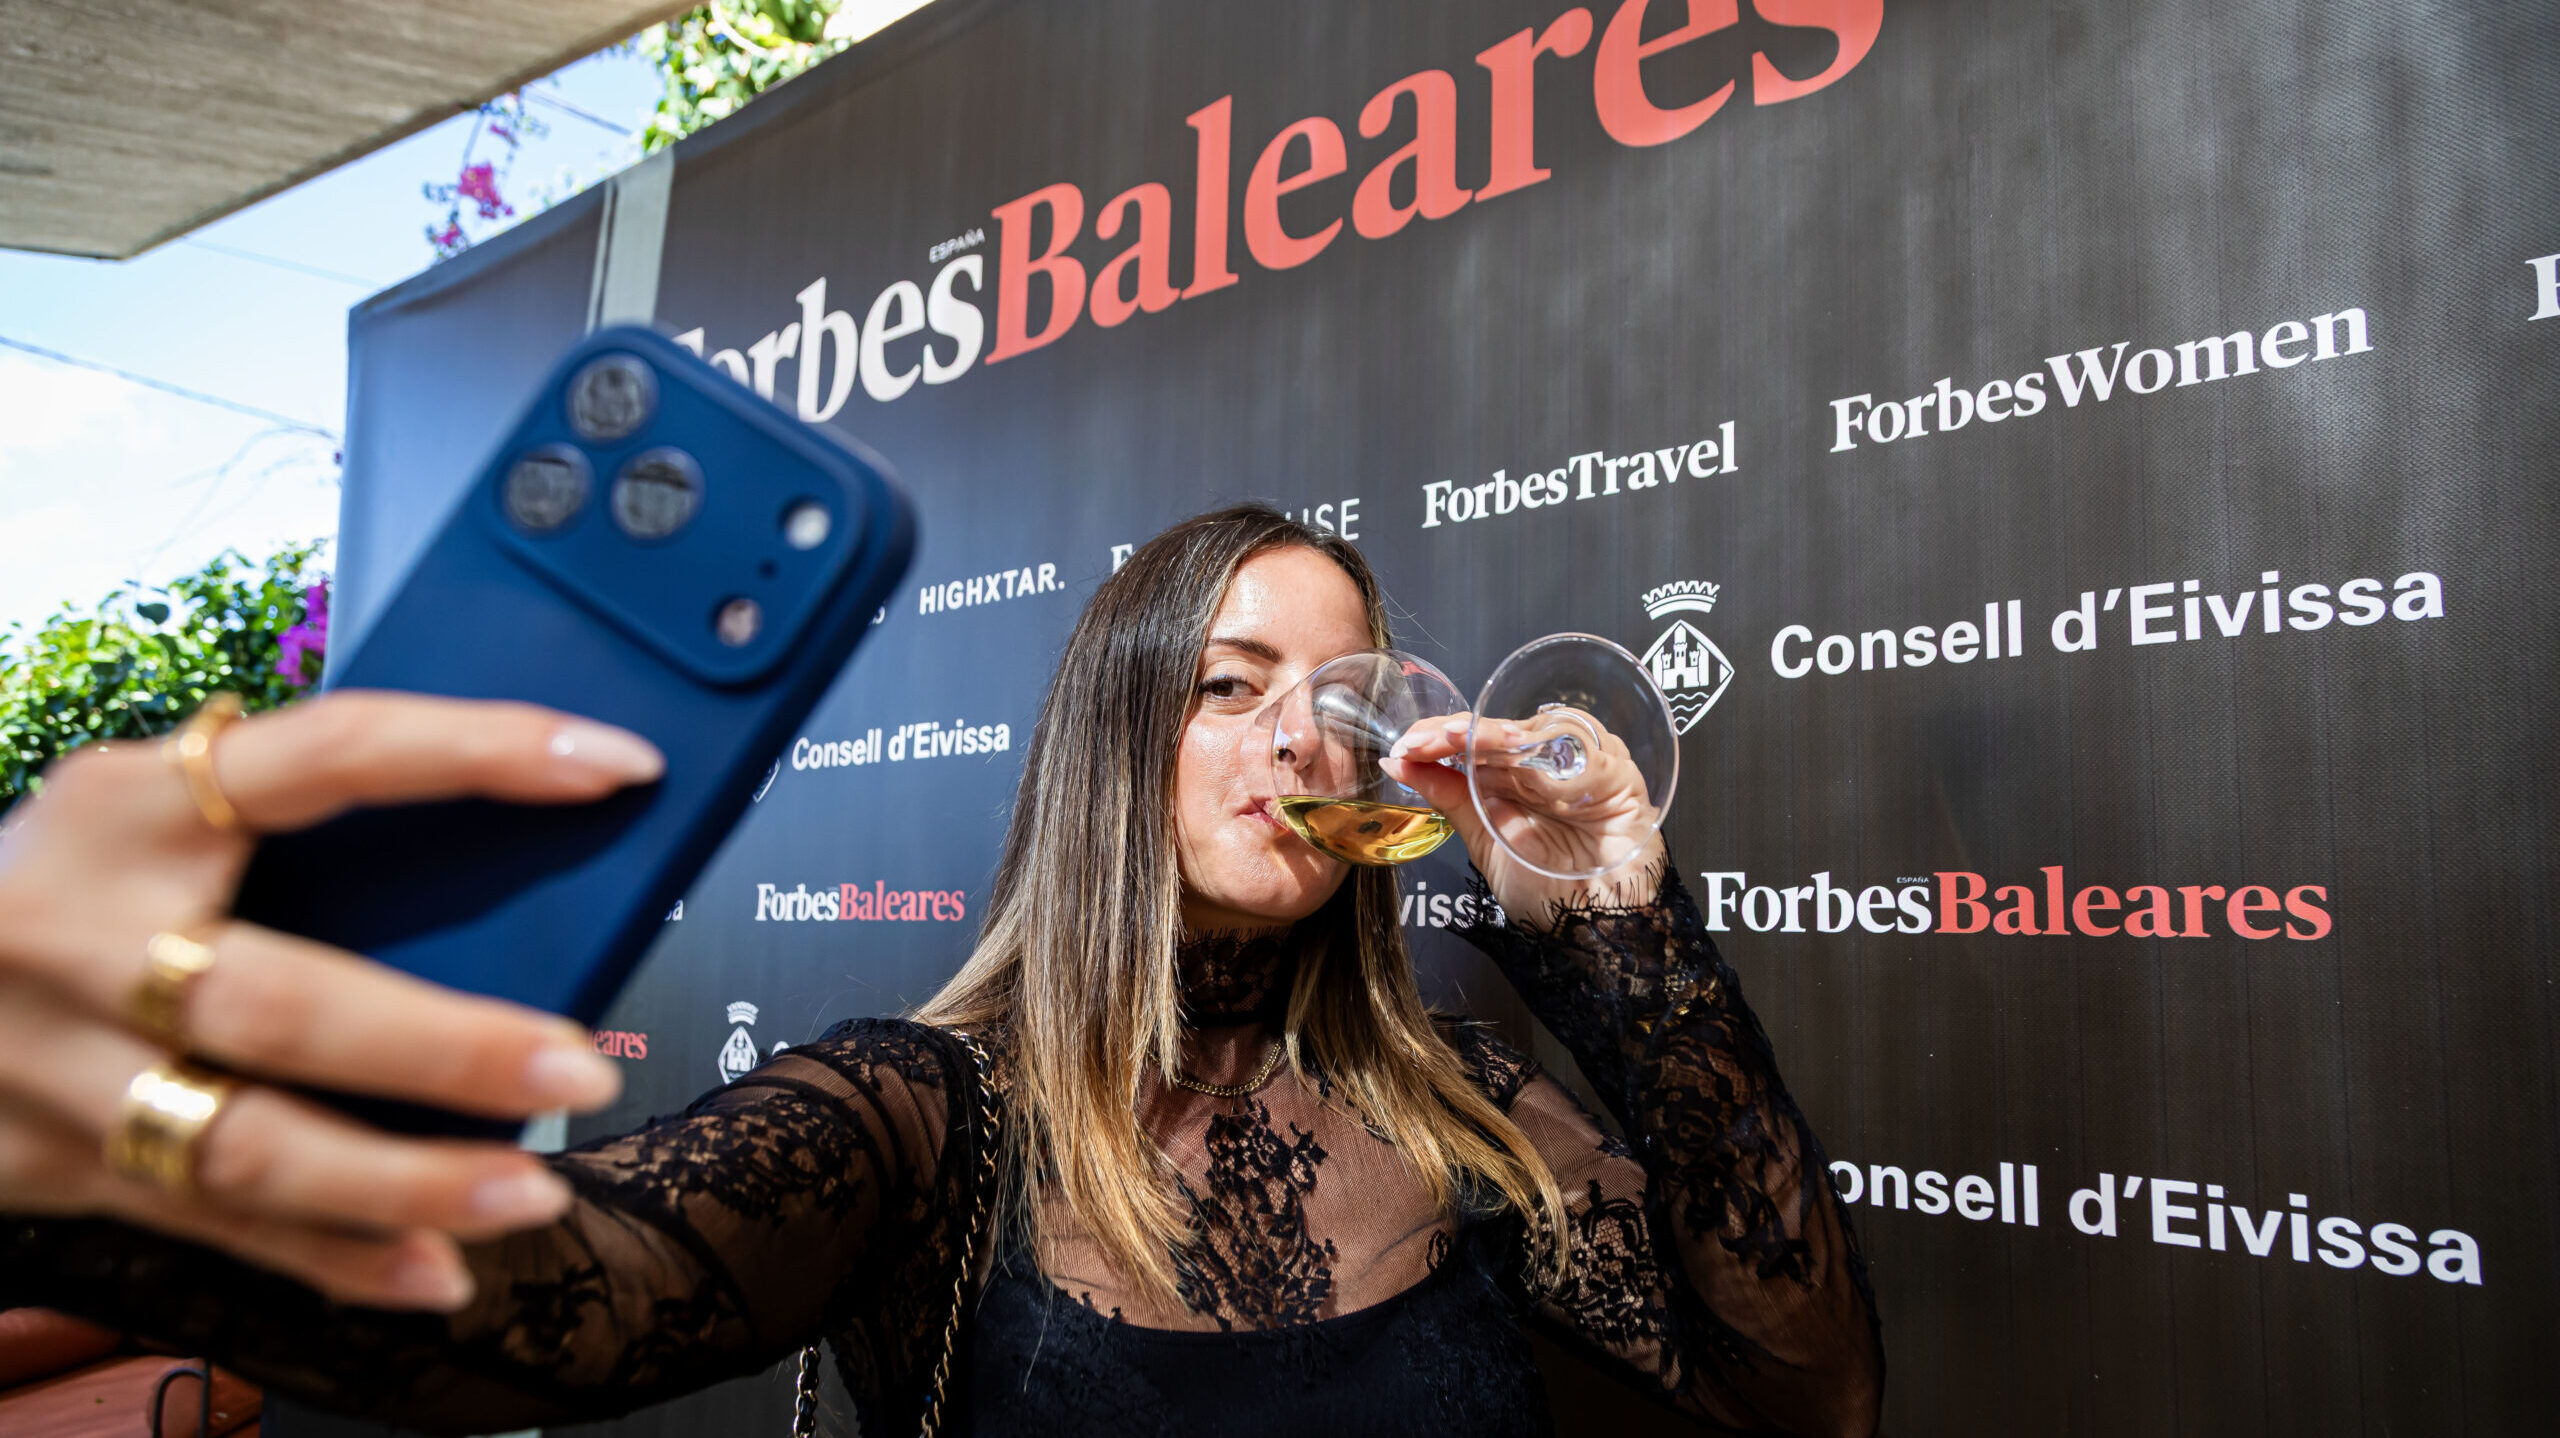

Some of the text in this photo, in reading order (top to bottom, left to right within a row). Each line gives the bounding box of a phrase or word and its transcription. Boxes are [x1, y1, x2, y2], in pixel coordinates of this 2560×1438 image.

[929, 228, 985, 264] ESPAÑA
[1829, 307, 2375, 453] ForbesWomen
[1421, 420, 1739, 529] ForbesTravel
[919, 562, 1065, 616] HIGHXTAR.
[1770, 570, 2445, 679] Consell d’Eivissa
[791, 718, 1011, 771] Consell d’Eivissa
[754, 880, 965, 922] ForbesBaleares
[1700, 865, 2333, 940] ForbesBaleares
[1828, 1160, 2482, 1285] onsell d’Eivissa
